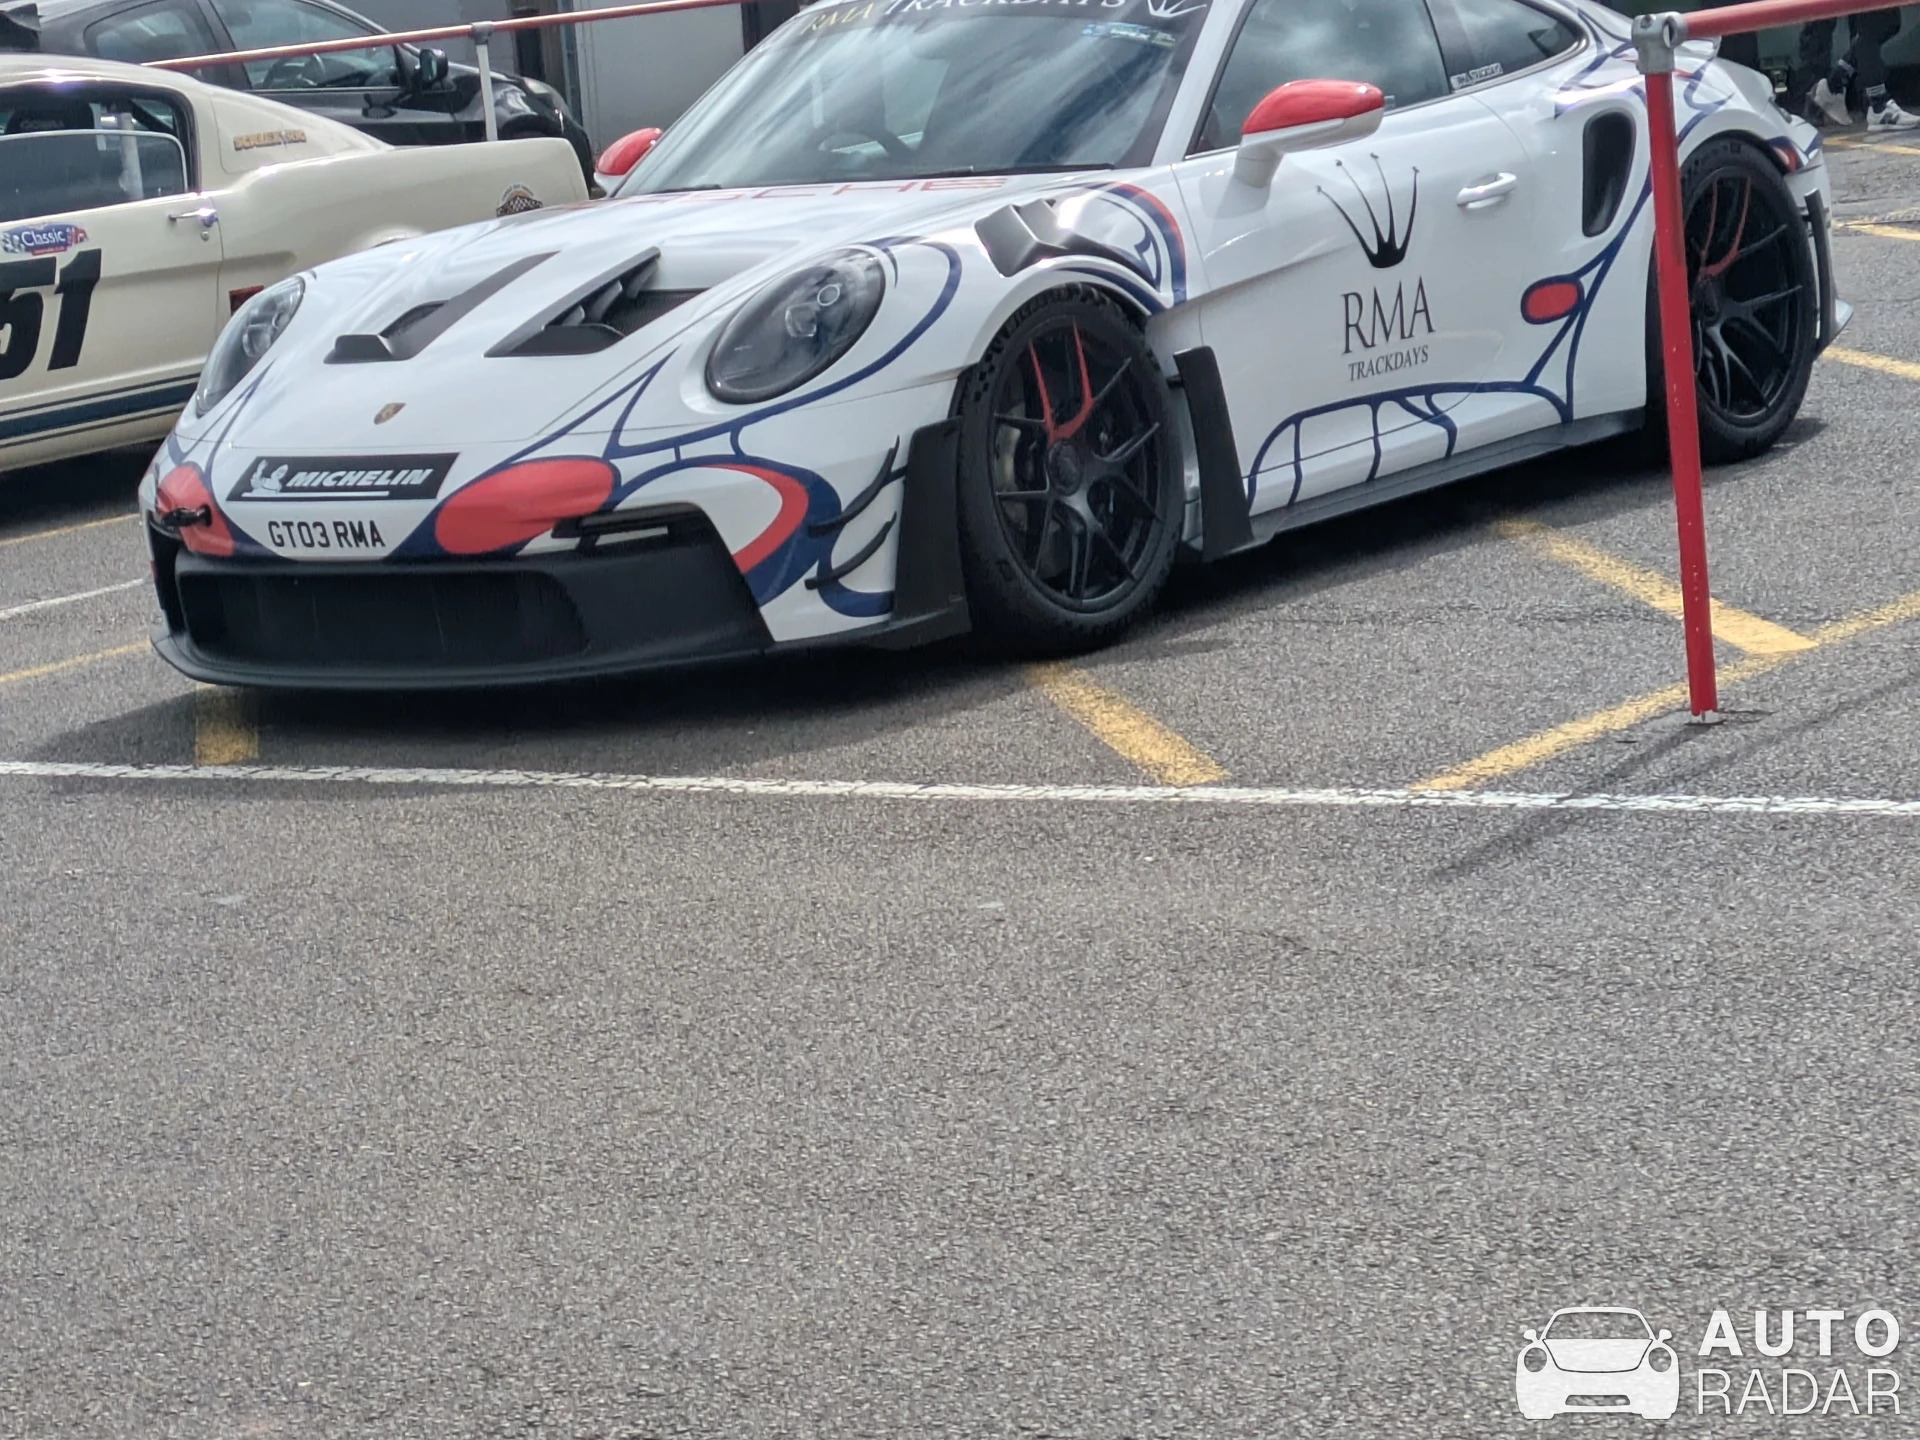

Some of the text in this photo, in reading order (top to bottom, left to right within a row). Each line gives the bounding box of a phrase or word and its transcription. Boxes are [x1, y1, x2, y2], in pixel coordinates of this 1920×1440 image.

[21, 228, 66, 247] Classic
[0, 248, 102, 381] 51
[1341, 275, 1437, 355] RMA
[1348, 344, 1430, 382] TRACKDAYS
[286, 468, 433, 487] MICHELIN
[333, 520, 386, 548] RMA
